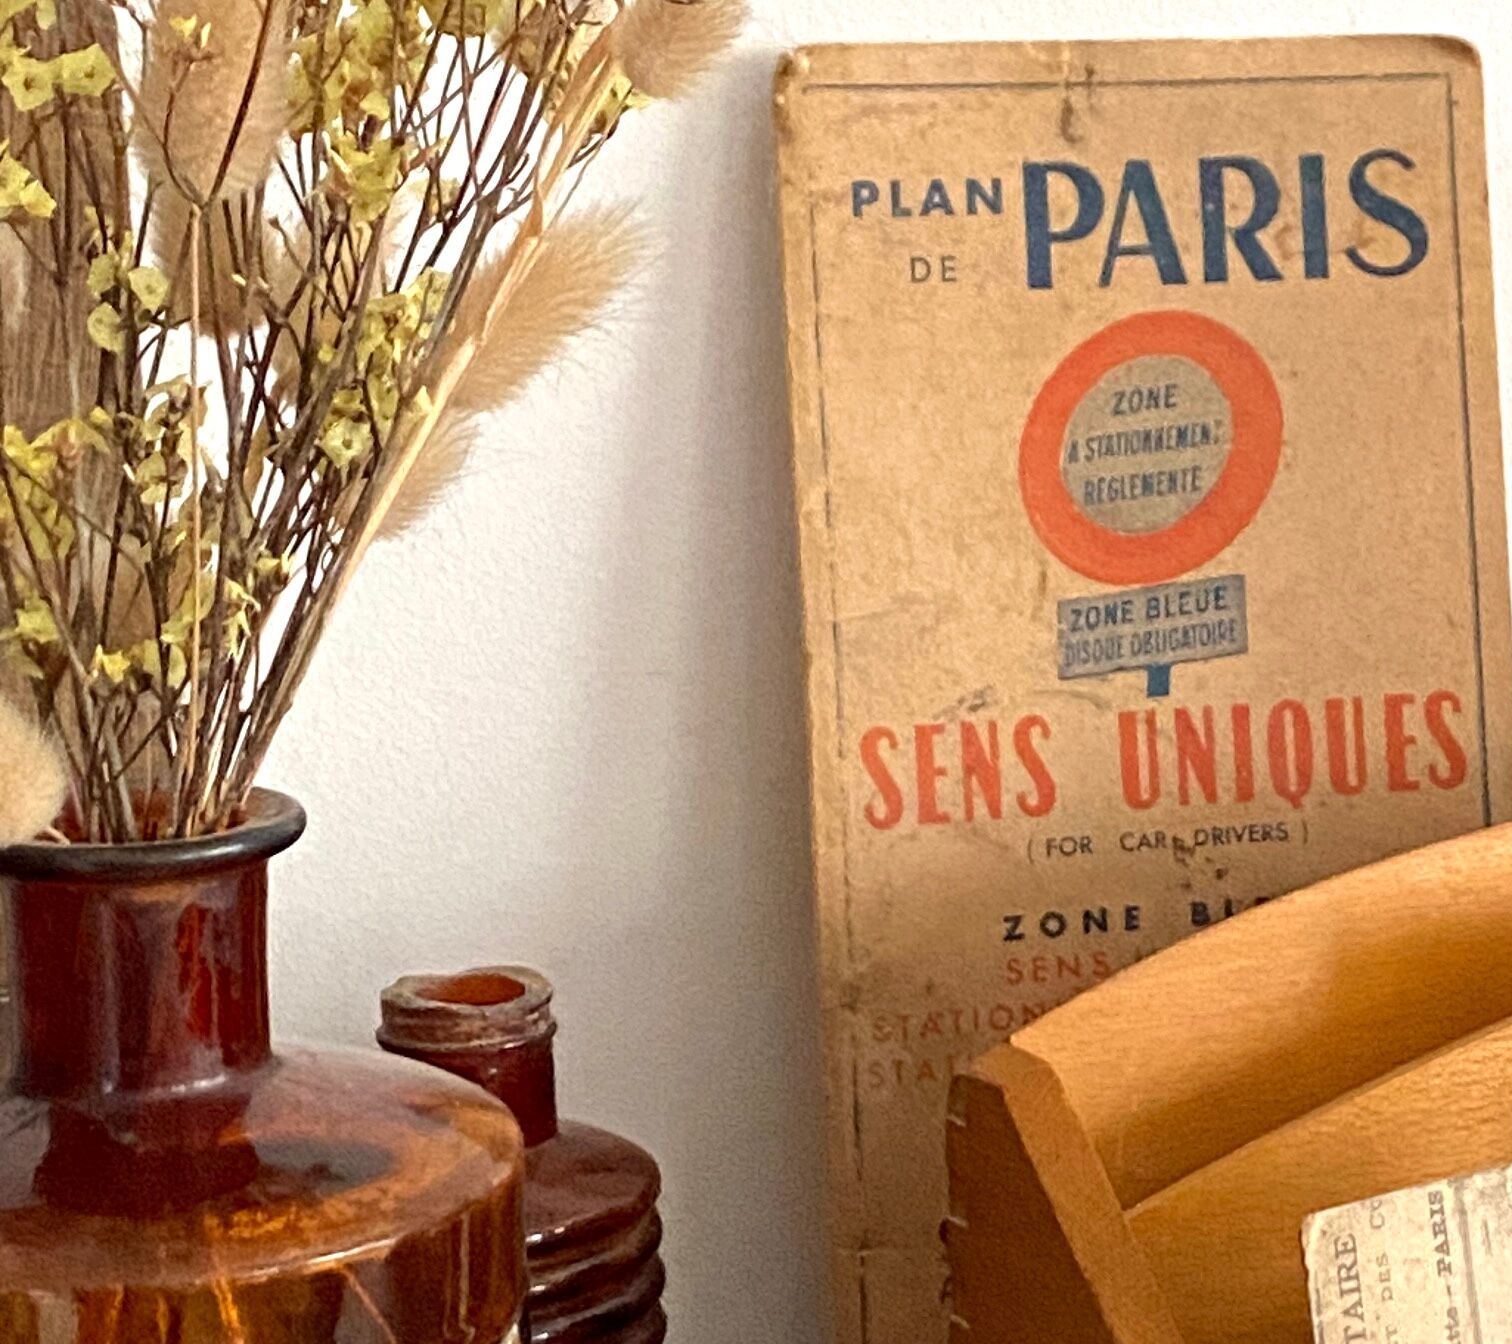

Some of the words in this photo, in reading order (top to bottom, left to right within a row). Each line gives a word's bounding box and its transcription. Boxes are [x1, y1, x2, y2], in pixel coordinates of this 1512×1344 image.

[850, 176, 1004, 219] PLAN
[1021, 146, 1431, 291] PARIS
[909, 254, 959, 285] DE
[1111, 382, 1179, 418] ZONE
[1069, 598, 1136, 634] ZONE
[1145, 584, 1229, 622] BLEUE
[1129, 618, 1237, 657] OBLIGATOIRE
[857, 712, 1059, 833] SENS
[1117, 689, 1470, 814] UNIQUES
[1002, 904, 1141, 943] ZONE
[1189, 895, 1271, 928] BL
[1005, 950, 1112, 986] SENS
[1427, 1189, 1453, 1277] PARIS
[1375, 1251, 1394, 1303] DES
